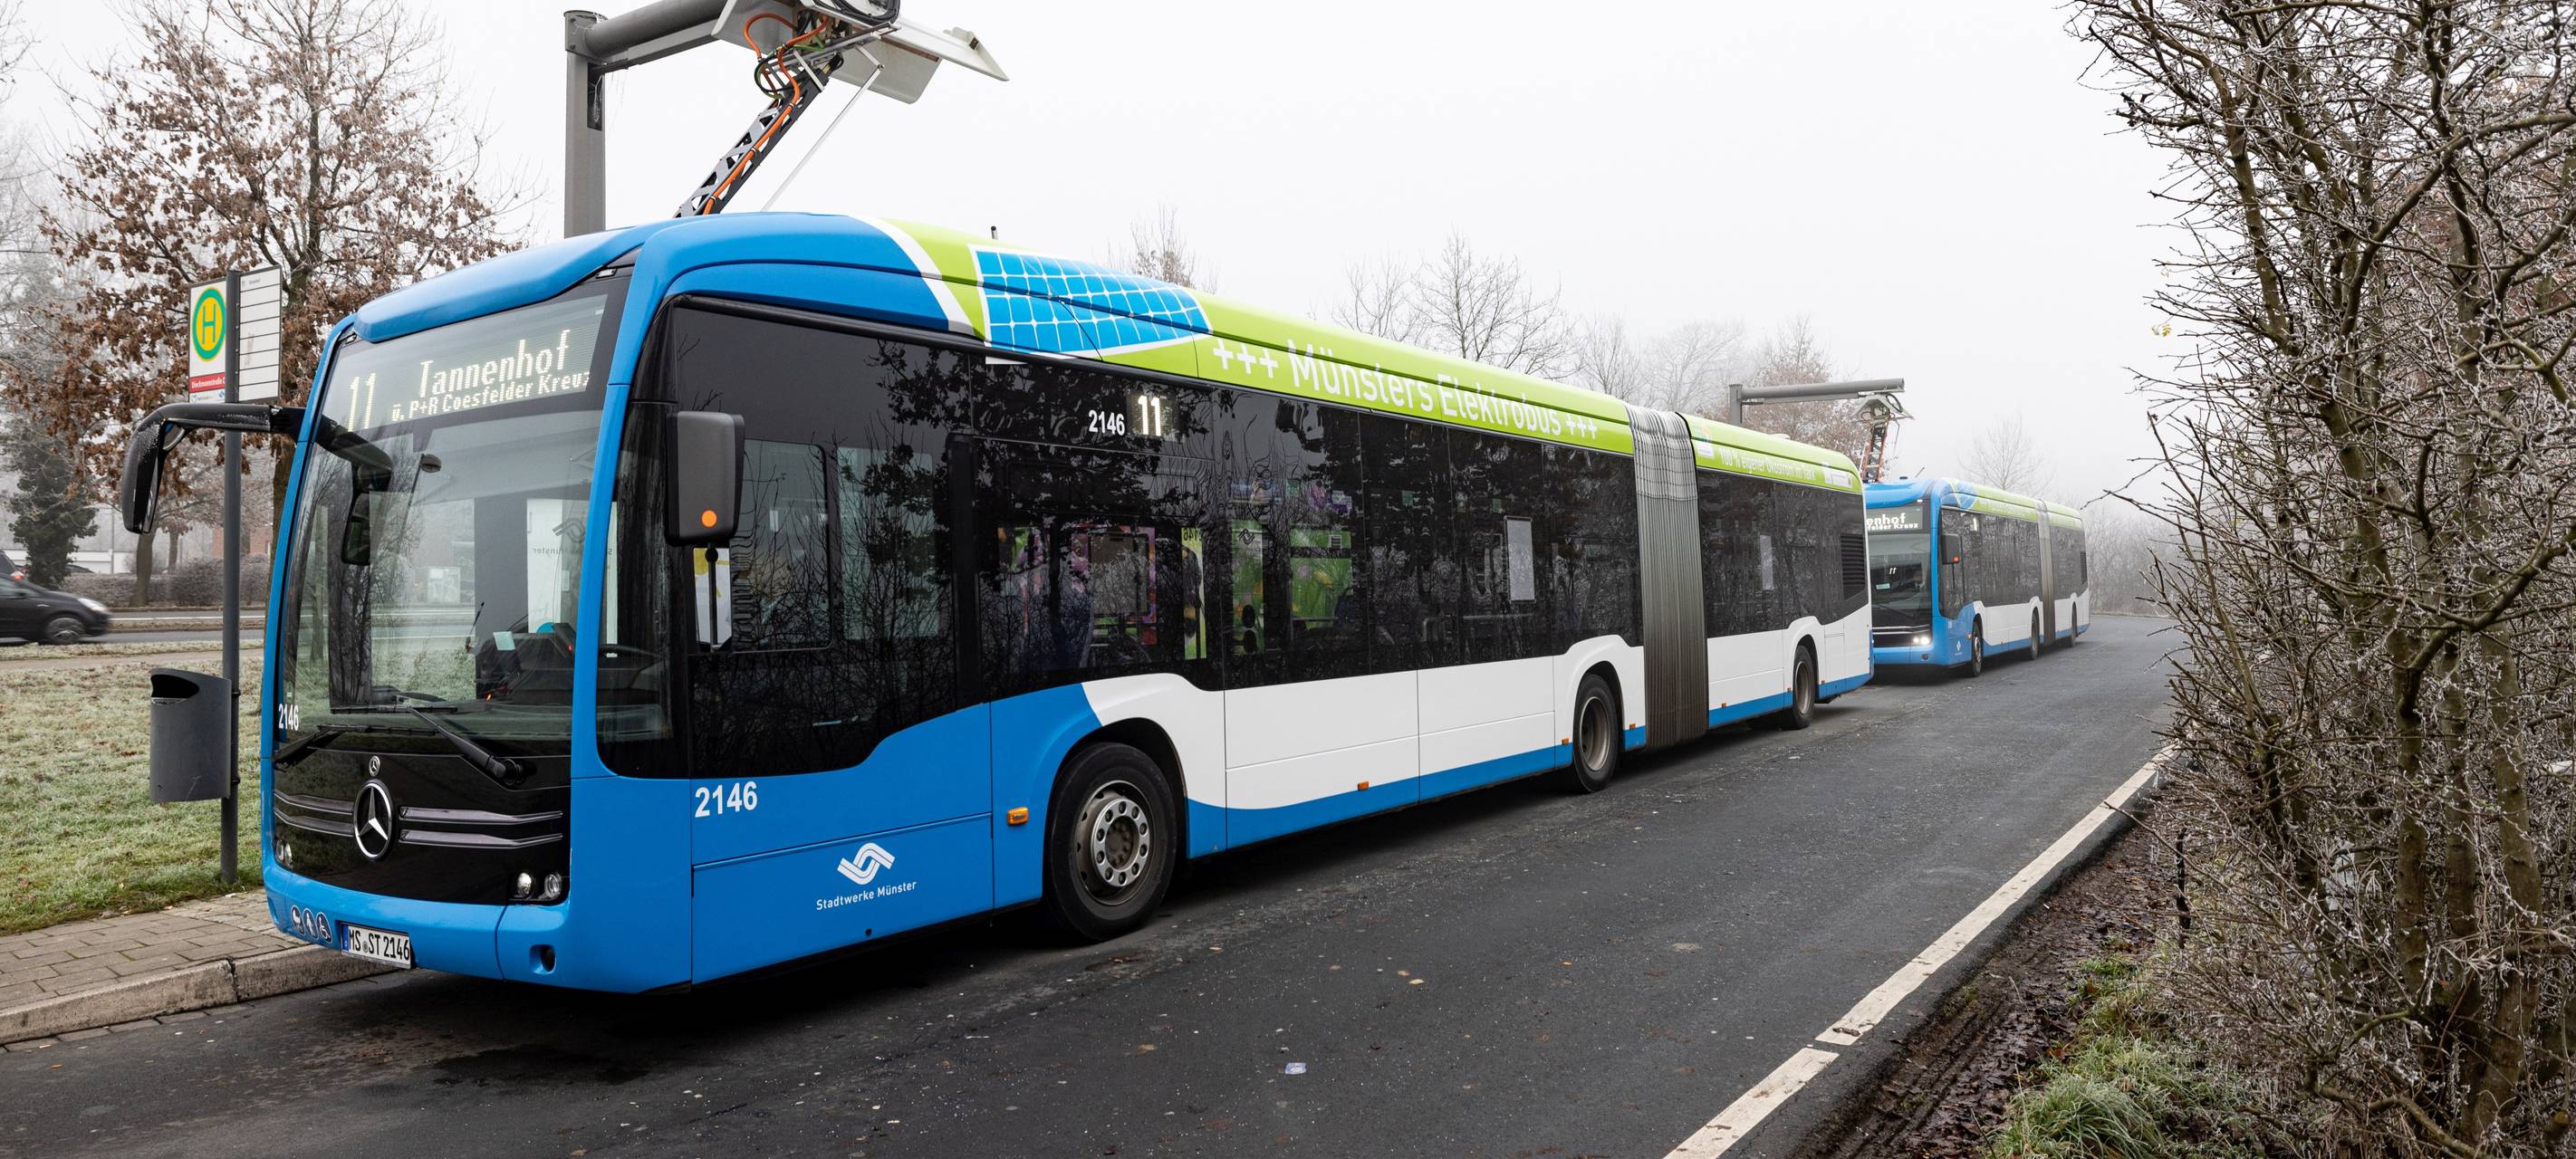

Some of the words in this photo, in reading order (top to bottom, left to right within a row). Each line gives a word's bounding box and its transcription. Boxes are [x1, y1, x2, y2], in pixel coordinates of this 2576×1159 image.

[202, 304, 216, 344] H
[418, 329, 571, 398] Tannenhof
[347, 372, 377, 432] 11
[409, 399, 438, 419] P+R
[442, 381, 533, 412] Coesfelder
[1288, 339, 1434, 412] Münsters
[1437, 373, 1562, 436] Elektrobus
[1089, 409, 1125, 436] 2146
[1138, 395, 1161, 436] 11
[1866, 512, 1906, 525] enhof
[278, 703, 299, 731] 2146
[695, 781, 758, 818] 2146
[816, 890, 874, 911] Stadtwerke
[877, 880, 917, 898] Münster
[349, 929, 360, 952] MS
[368, 933, 380, 955] ST
[383, 935, 409, 961] 2146
